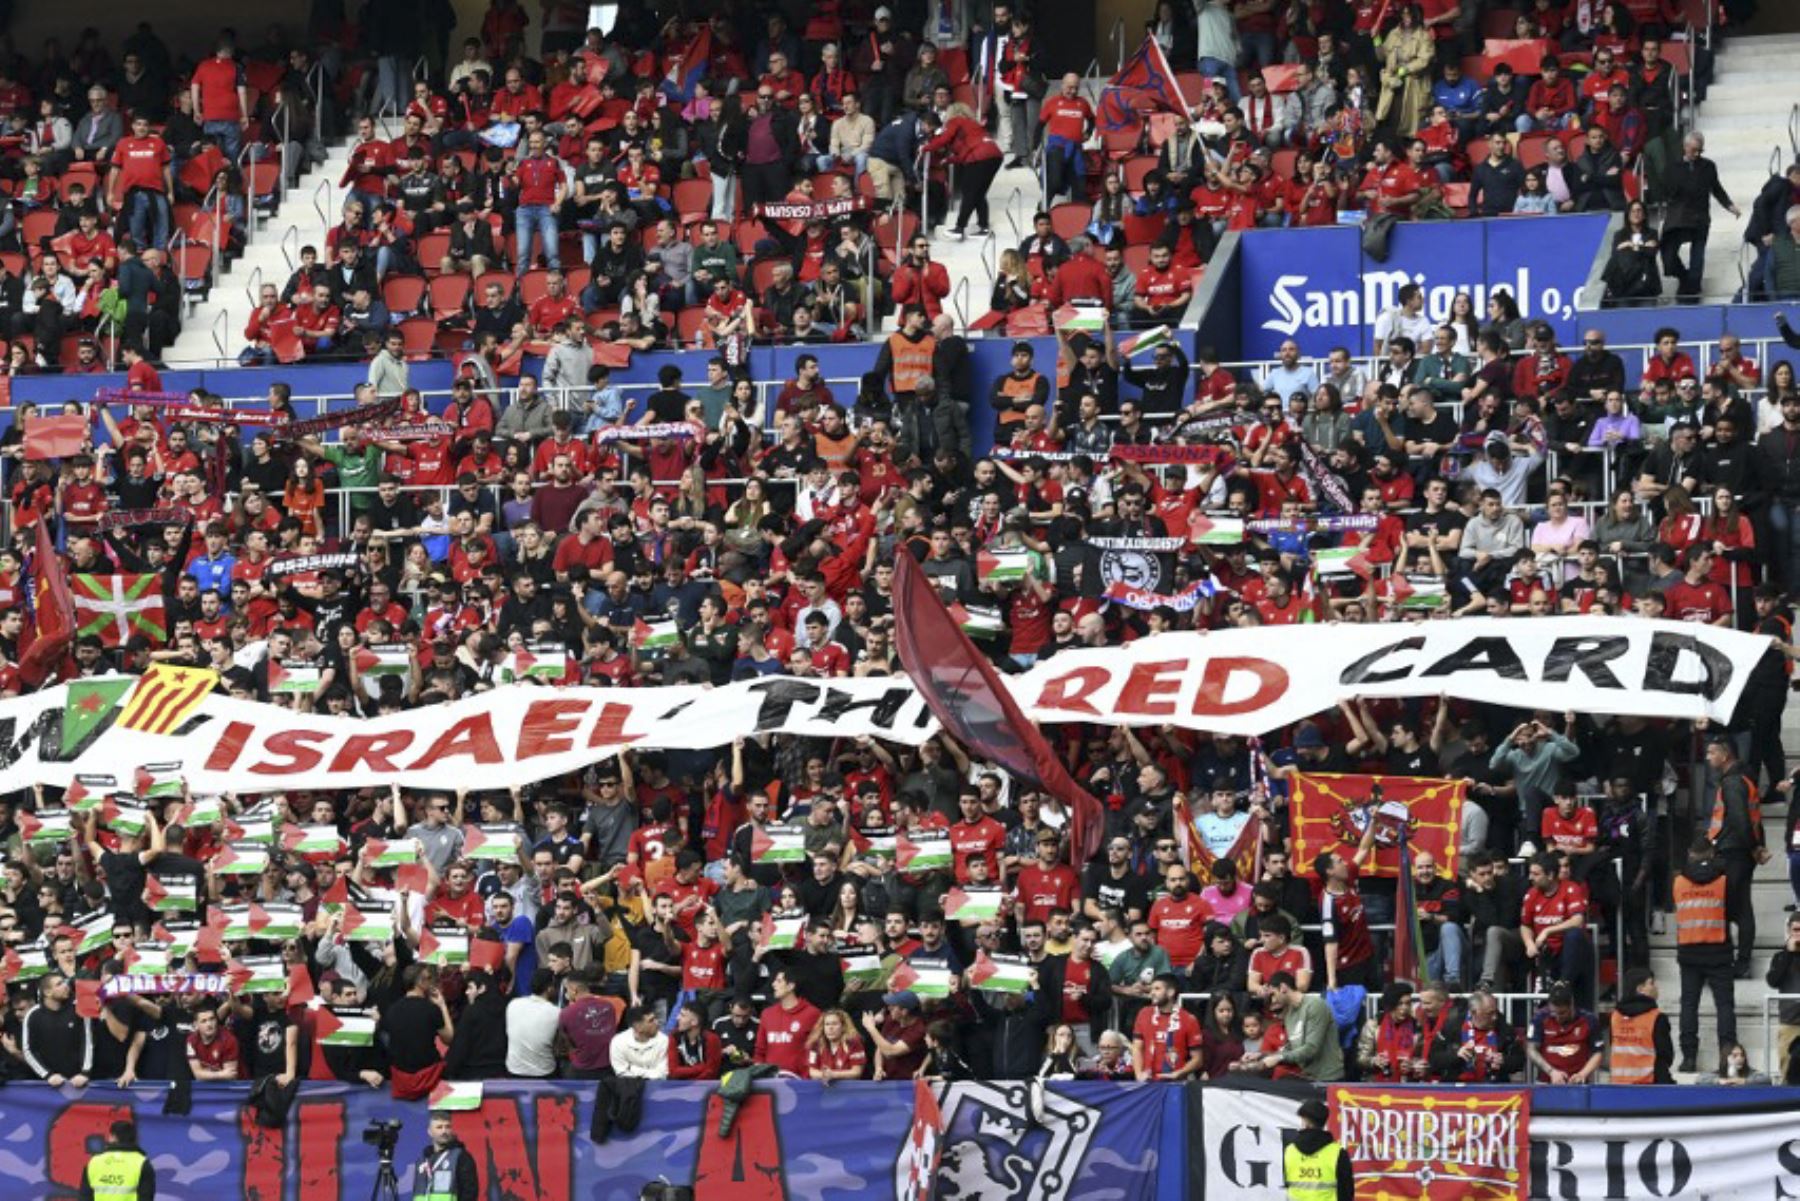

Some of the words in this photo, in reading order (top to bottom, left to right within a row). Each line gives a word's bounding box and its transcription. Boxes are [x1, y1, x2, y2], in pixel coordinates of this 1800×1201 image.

[1122, 446, 1212, 462] OSASUNA
[1032, 656, 1289, 715] RED
[1339, 631, 1734, 701] CARD
[1339, 1105, 1519, 1171] ERRIBERRI
